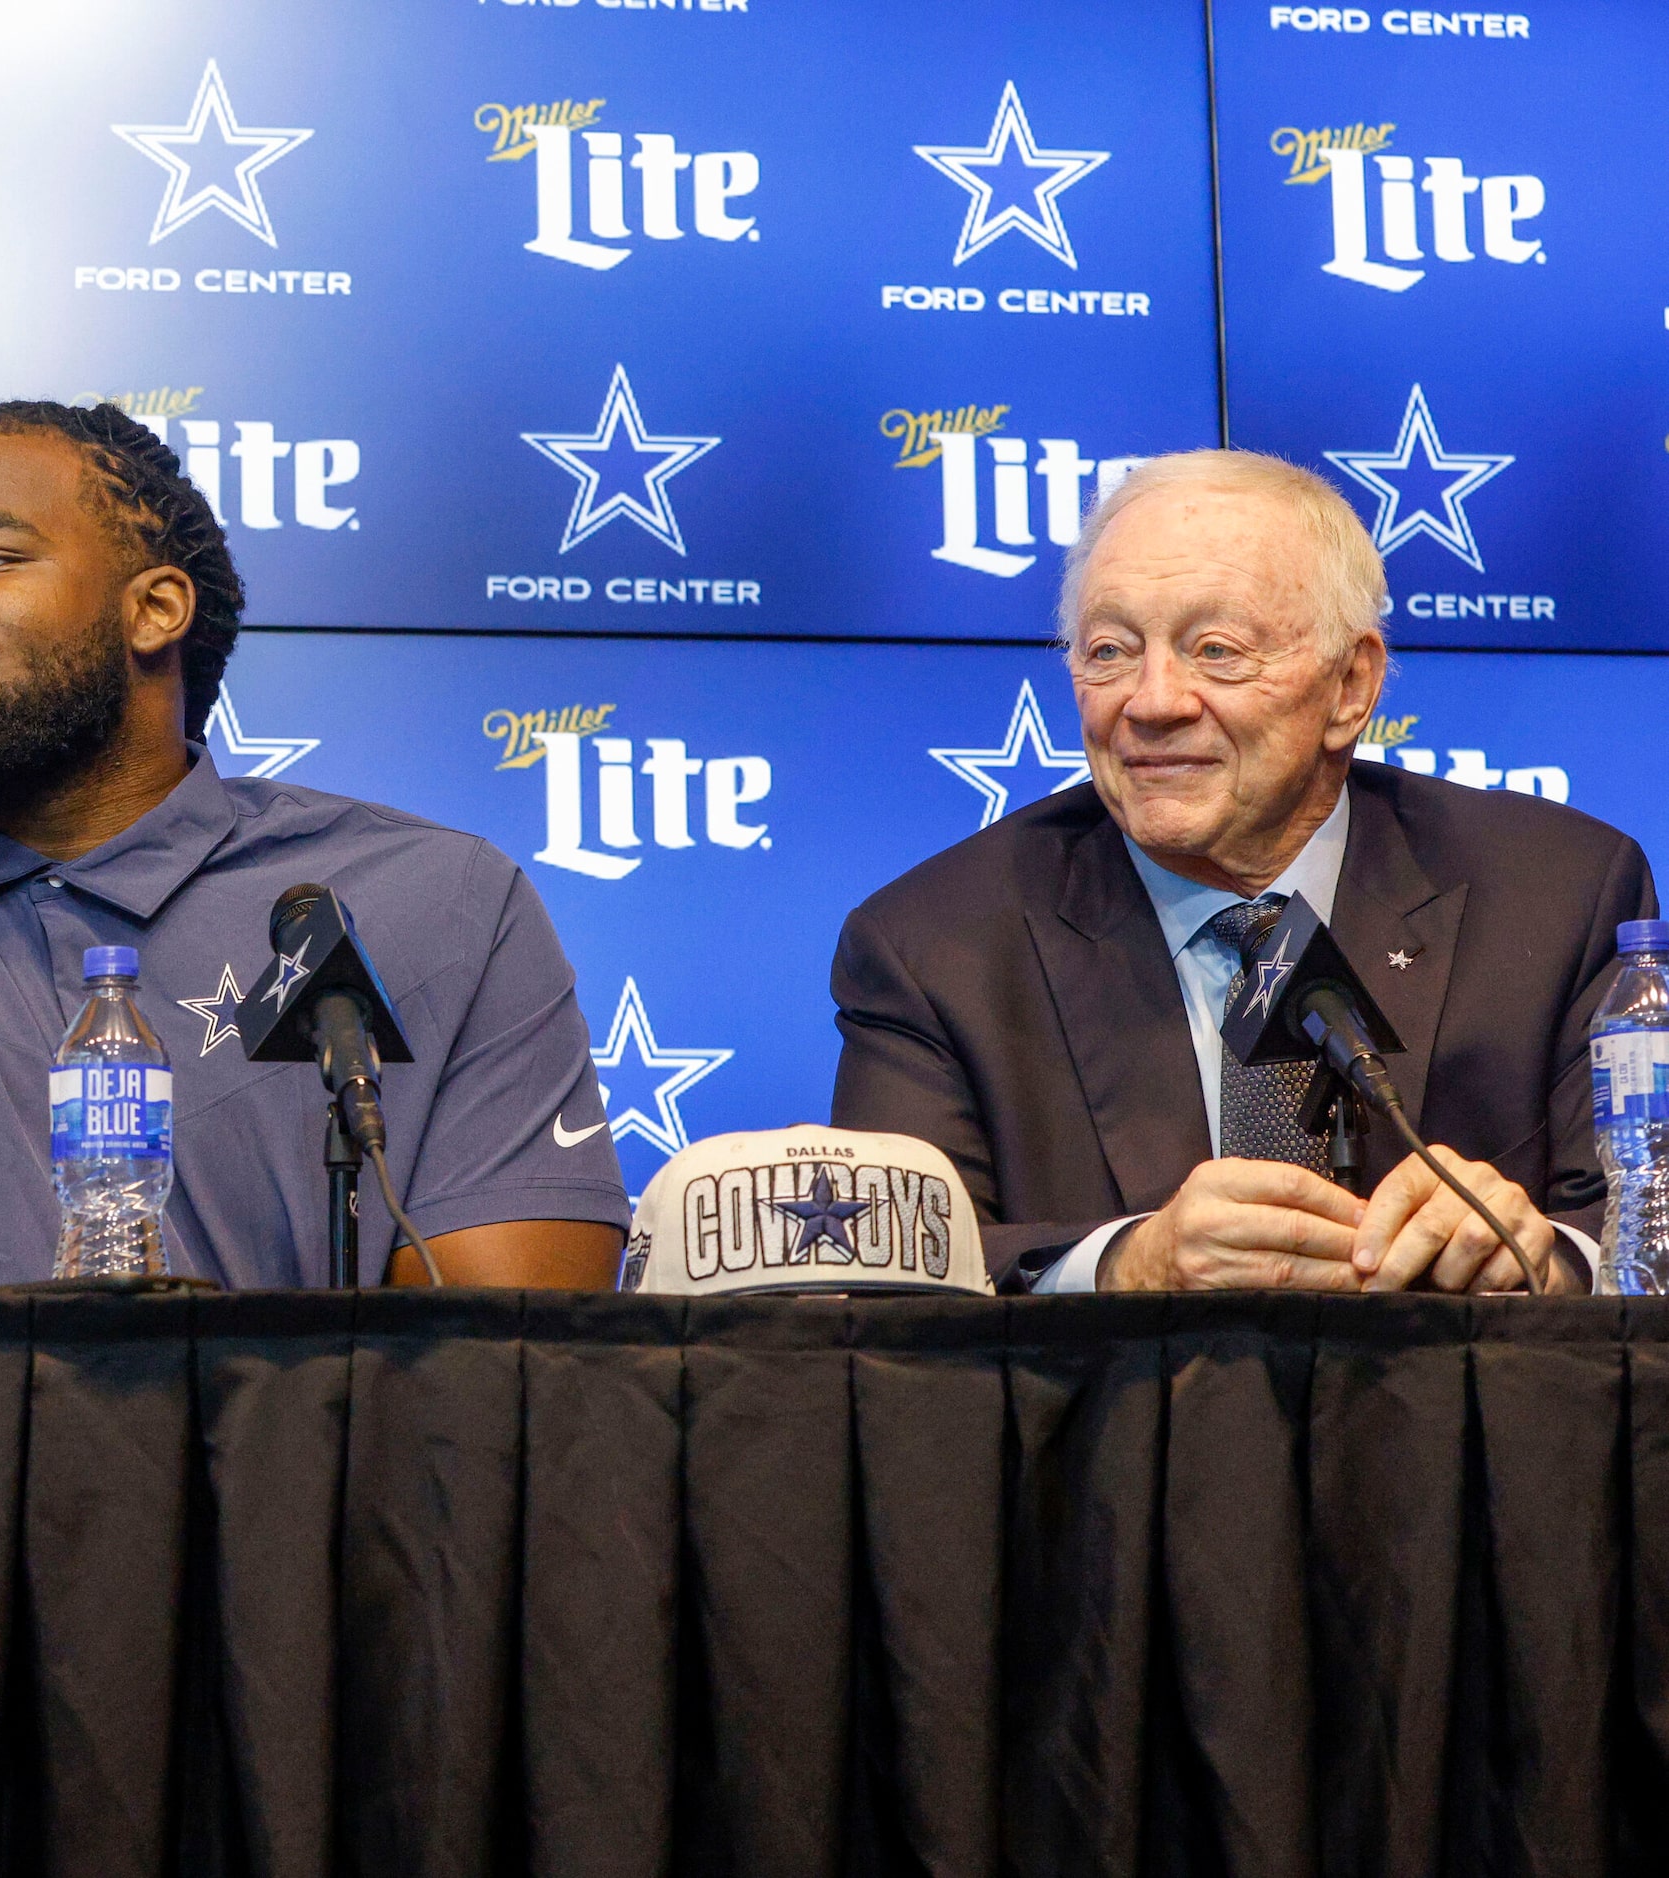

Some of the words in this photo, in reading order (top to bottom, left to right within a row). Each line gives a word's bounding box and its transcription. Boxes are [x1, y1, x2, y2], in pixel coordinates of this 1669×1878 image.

[1270, 6, 1371, 33] FORD
[1382, 10, 1530, 39] CENTER
[474, 99, 606, 162] Miller
[1270, 122, 1396, 185] Miller
[74, 267, 181, 291] FORD
[194, 268, 352, 295] CENTER
[881, 285, 985, 312] FORD
[998, 288, 1150, 316] CENTER
[880, 404, 1010, 470] Miller
[486, 576, 592, 600] FORD
[605, 578, 761, 604] CENTER
[1406, 593, 1556, 620] CENTER
[483, 704, 616, 771] Miller
[87, 1069, 141, 1101] DEJA
[87, 1102, 141, 1135] BLUE
[786, 1146, 855, 1159] DALLAS
